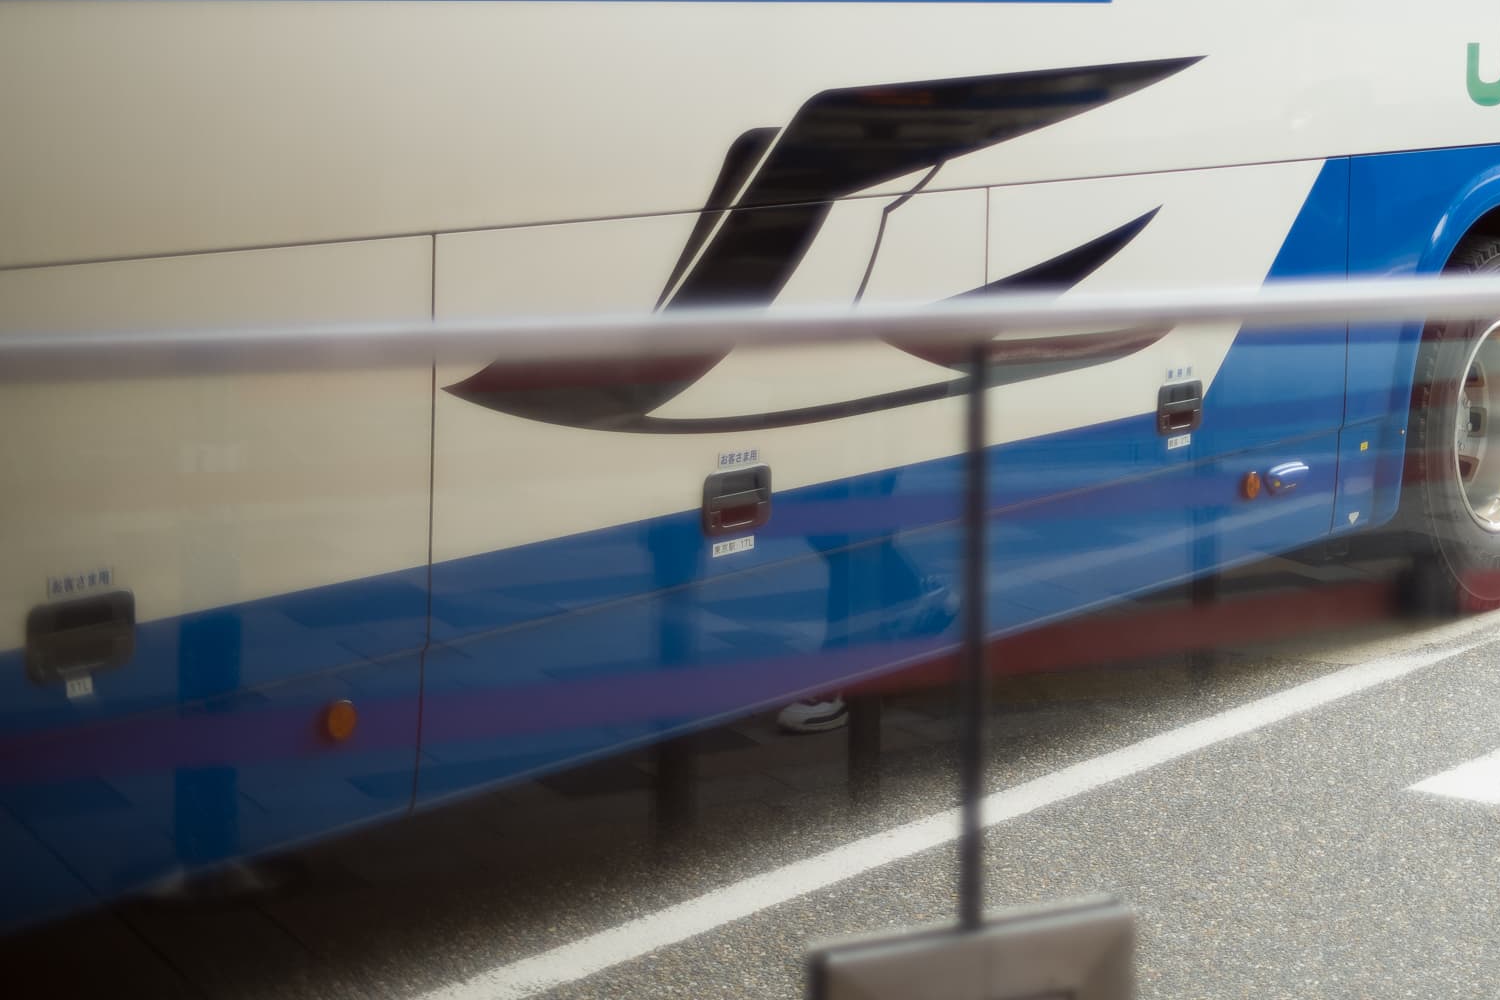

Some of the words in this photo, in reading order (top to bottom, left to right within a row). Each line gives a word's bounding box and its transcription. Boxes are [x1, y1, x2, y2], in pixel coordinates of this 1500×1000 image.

[720, 449, 758, 465] お客さま用
